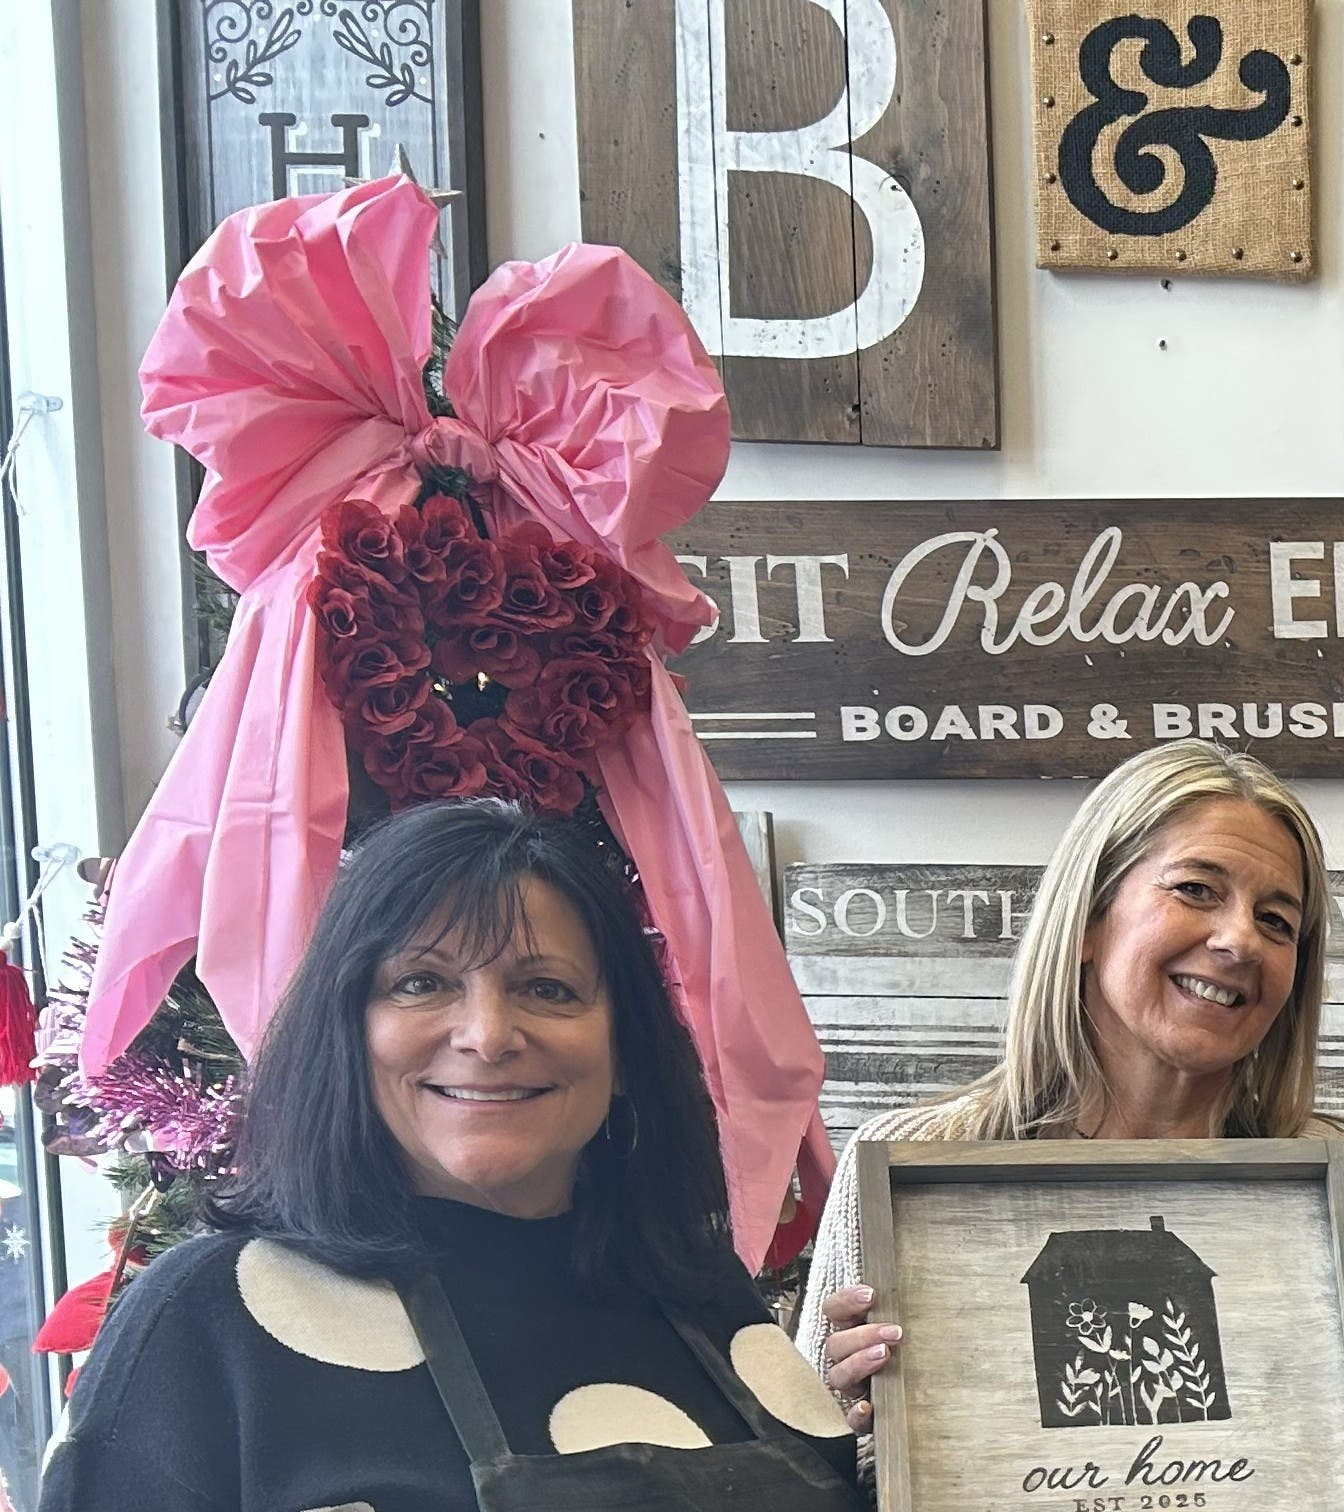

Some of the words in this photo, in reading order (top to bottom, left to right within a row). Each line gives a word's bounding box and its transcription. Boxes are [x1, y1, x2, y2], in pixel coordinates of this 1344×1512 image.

[1057, 14, 1292, 237] &
[675, 0, 926, 359] B
[881, 525, 1237, 656] Relax
[840, 704, 1064, 742] BOARD
[1086, 702, 1132, 740] &
[790, 887, 1036, 940] SOUTH
[1021, 1458, 1110, 1494] our
[1124, 1434, 1257, 1488] home
[1139, 1491, 1207, 1511] 2025
